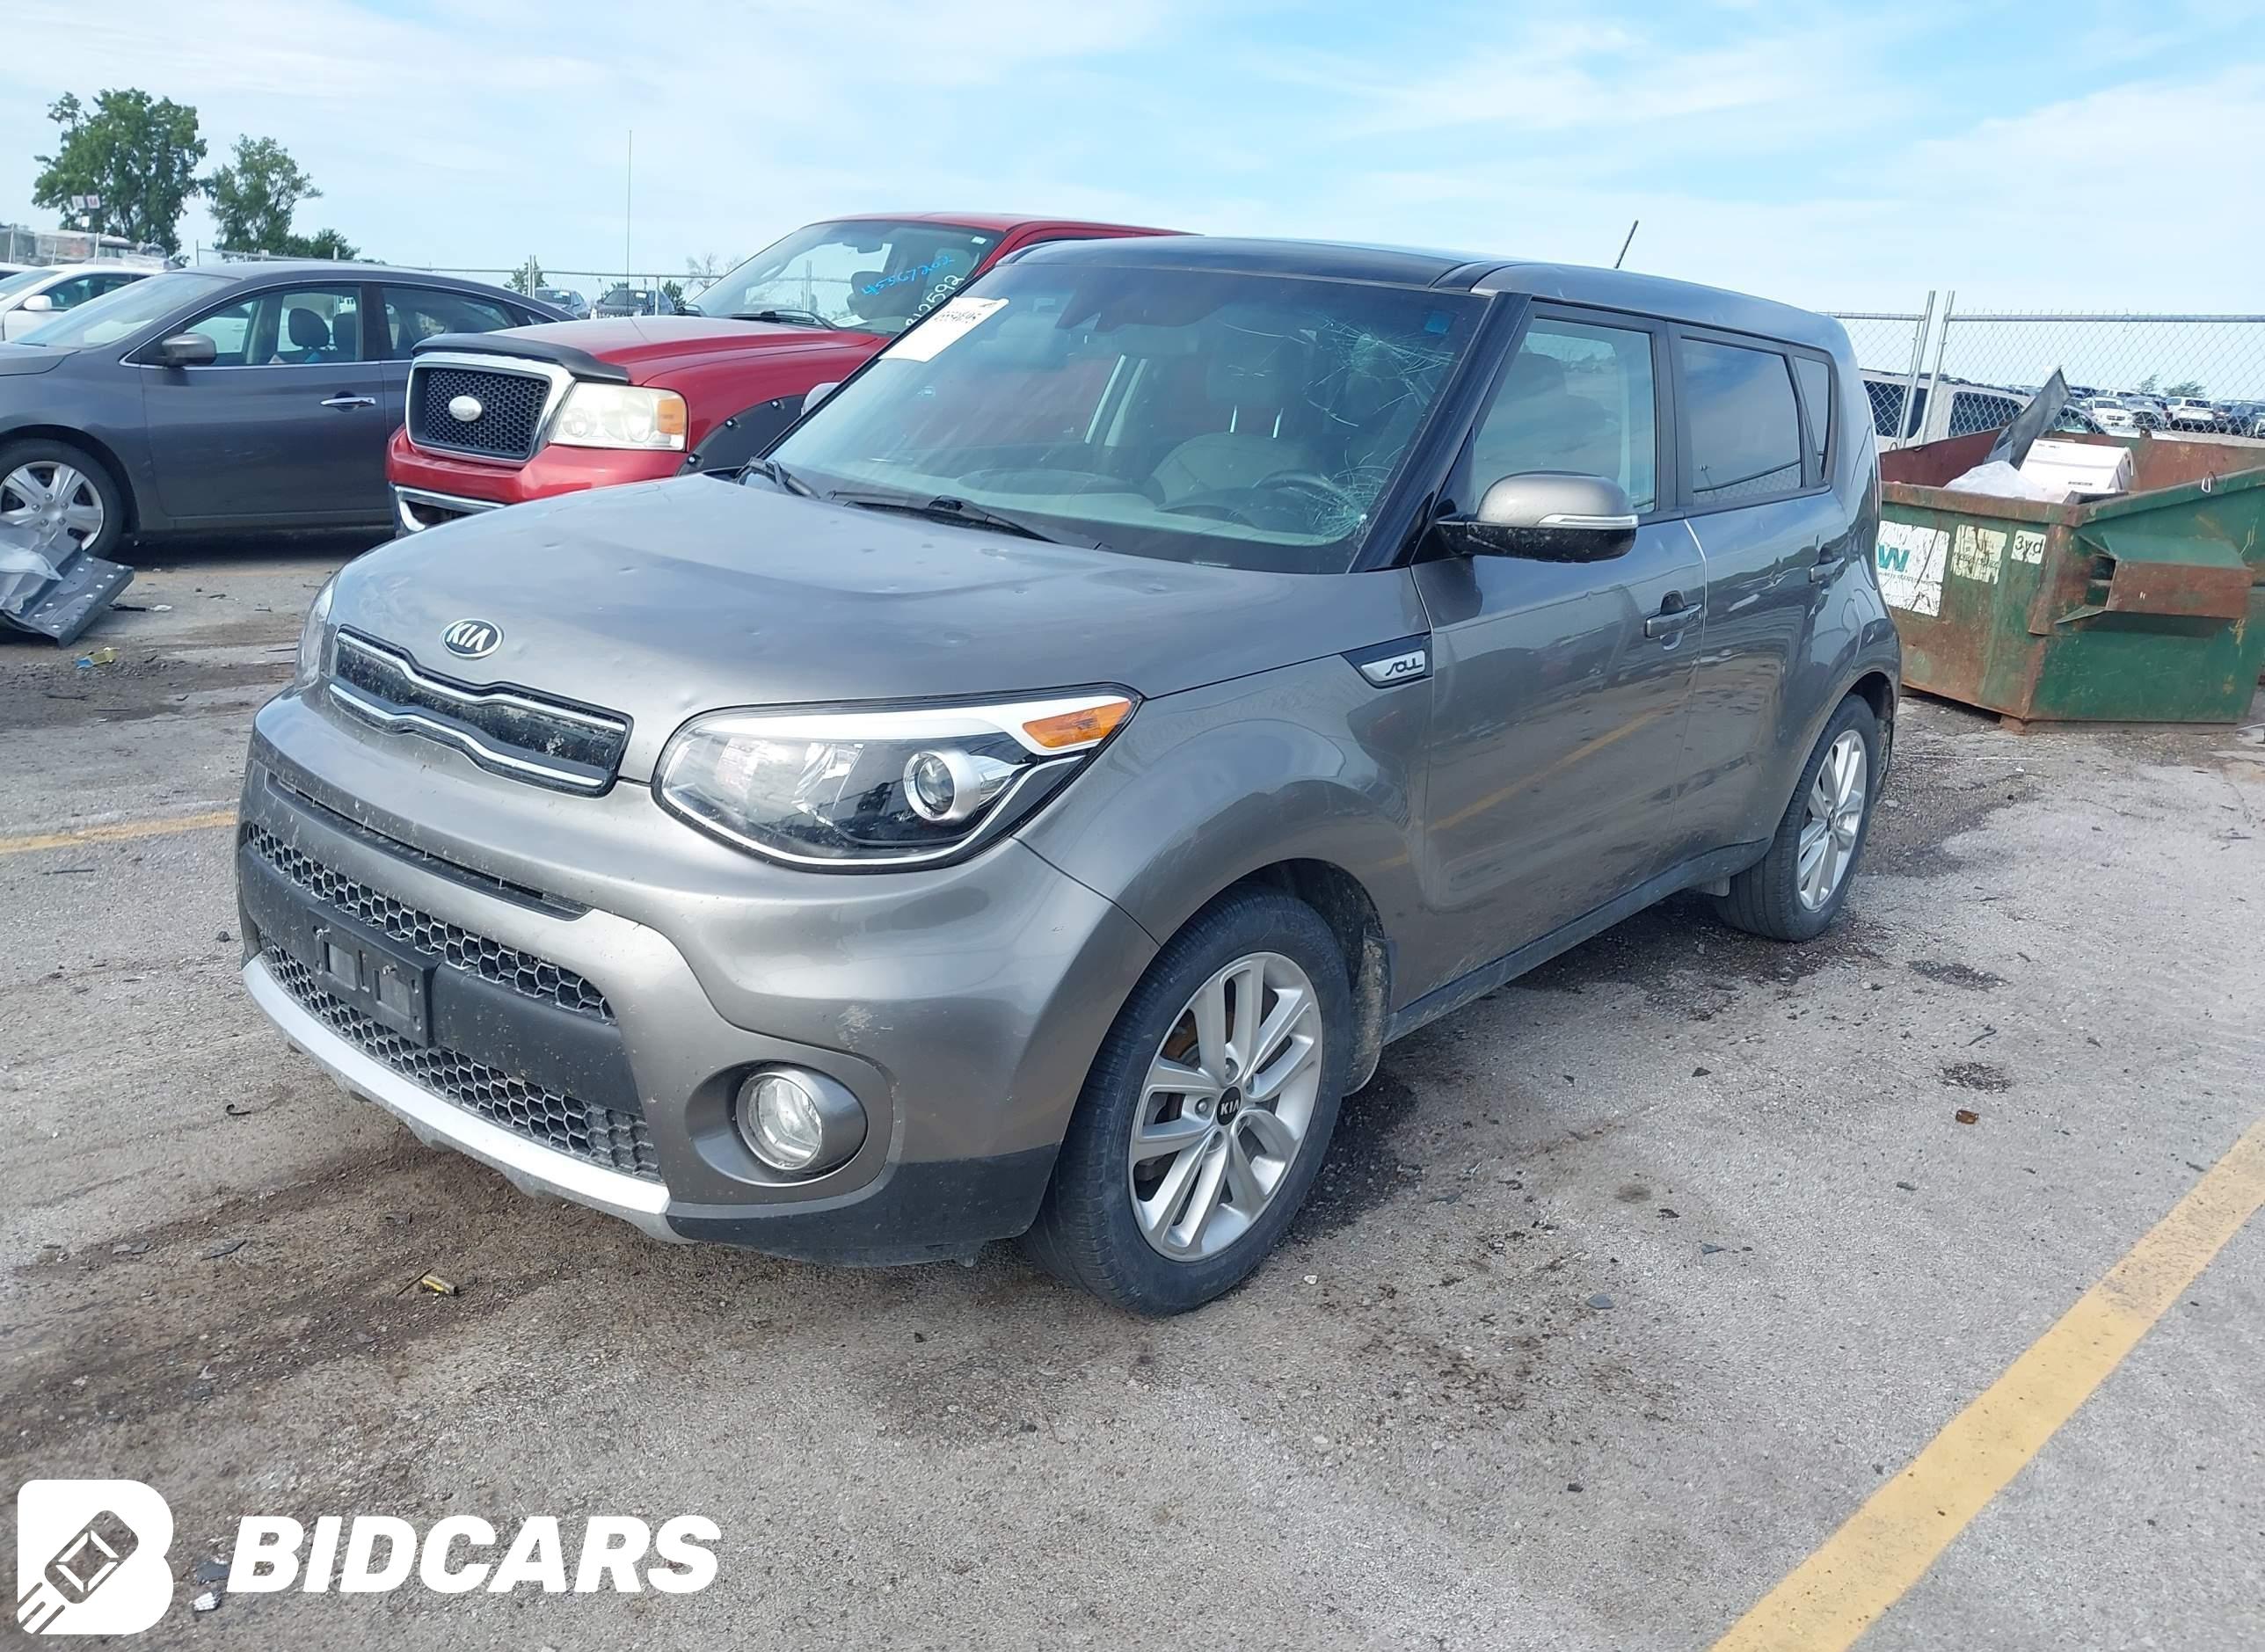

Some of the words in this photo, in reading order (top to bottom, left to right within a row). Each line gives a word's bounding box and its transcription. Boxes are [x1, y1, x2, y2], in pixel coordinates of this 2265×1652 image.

[2015, 535, 2044, 560] 3yd
[445, 622, 491, 651] KIA
[1220, 1099, 1239, 1116] KIA
